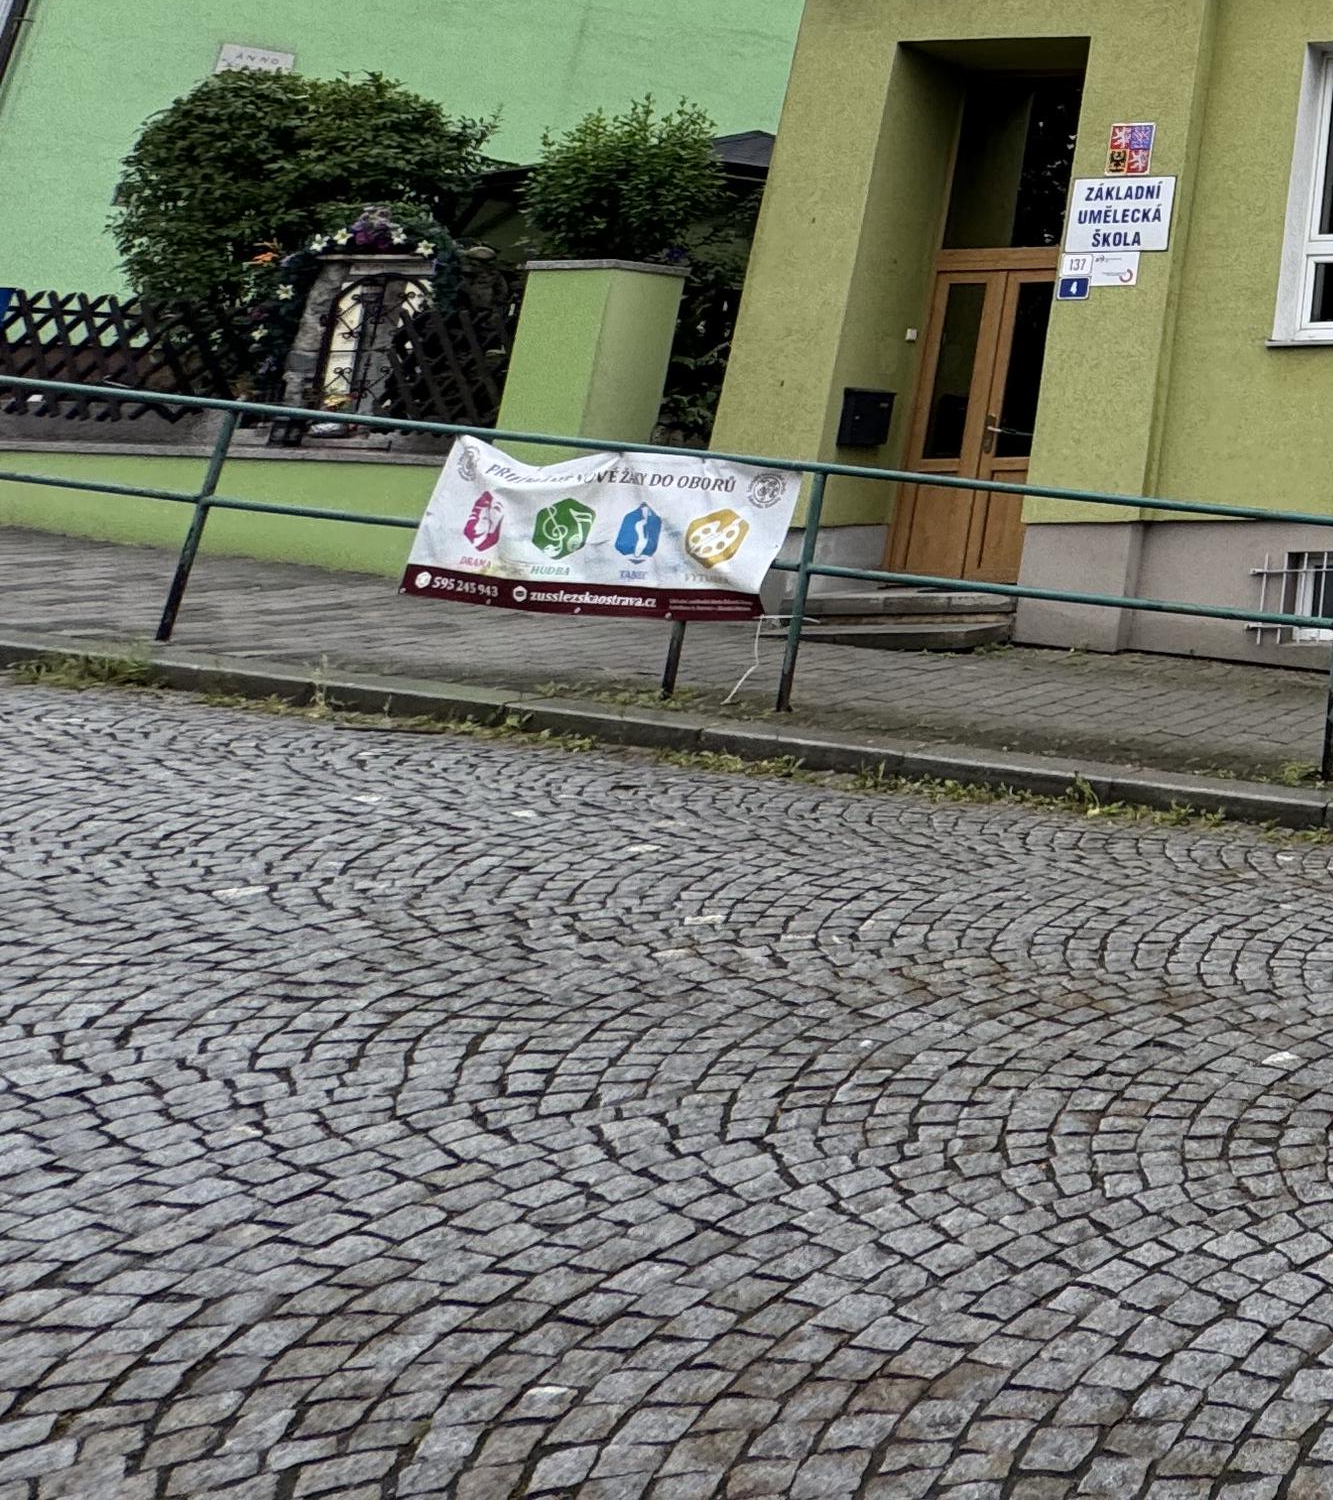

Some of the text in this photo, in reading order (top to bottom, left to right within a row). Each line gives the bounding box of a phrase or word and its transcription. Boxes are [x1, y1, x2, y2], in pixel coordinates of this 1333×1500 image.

[1084, 181, 1163, 202] ZÁKLADNÍ
[1077, 204, 1162, 225] UMĚLECKÁ
[1091, 229, 1142, 248] ŠKOLA
[1069, 258, 1087, 271] 137
[1069, 281, 1078, 295] 4
[650, 473, 674, 488] DO
[677, 475, 737, 493] OBORŮ
[529, 565, 571, 576] HUDBA
[432, 576, 499, 598] 595 245 943
[529, 589, 657, 608] zusslezskaostrava.cz
